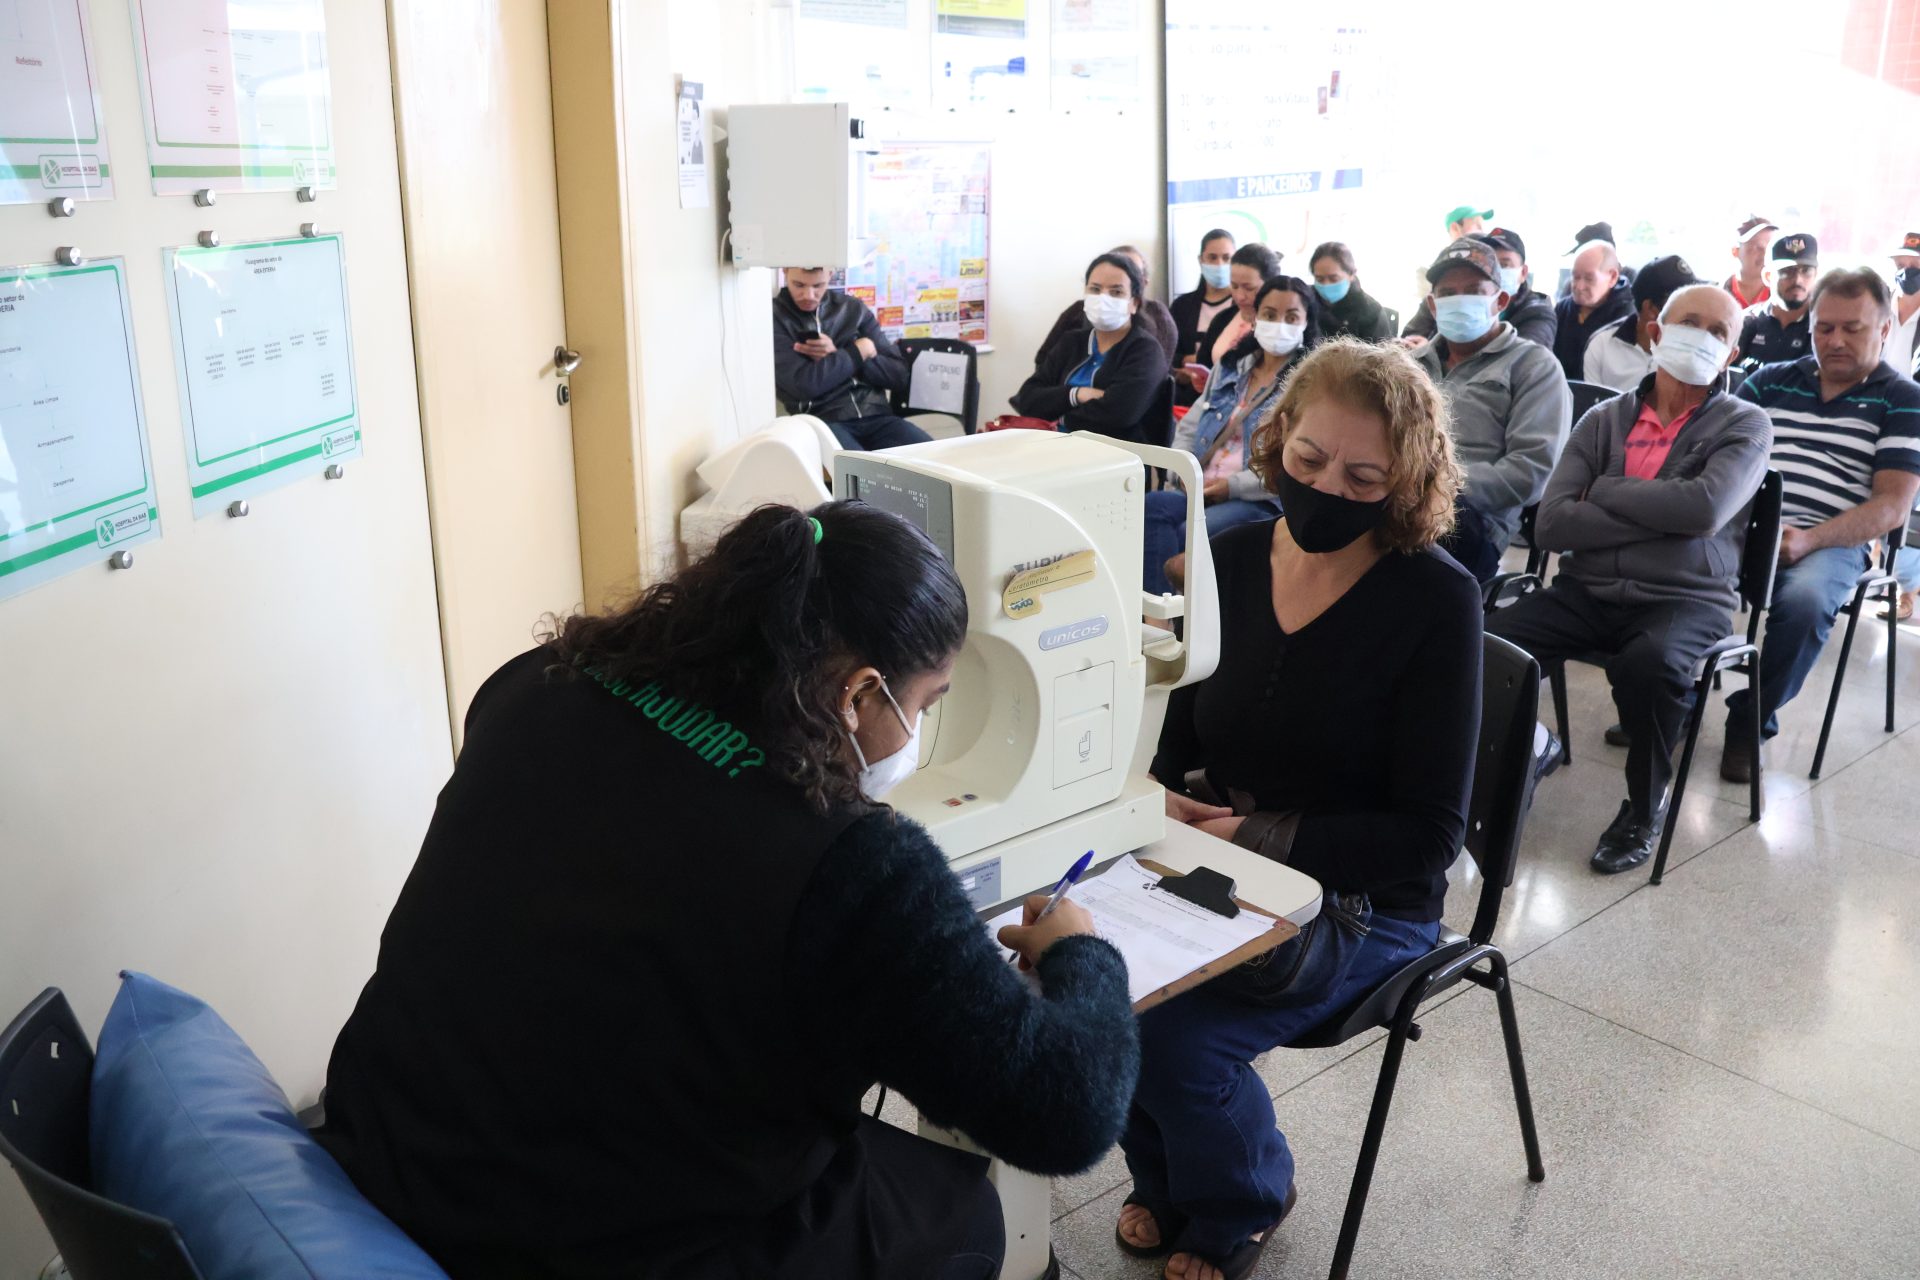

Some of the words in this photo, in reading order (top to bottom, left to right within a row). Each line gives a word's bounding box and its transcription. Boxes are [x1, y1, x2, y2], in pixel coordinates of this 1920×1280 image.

[1237, 178, 1246, 198] E
[1247, 173, 1312, 197] PARCEIROS
[1785, 238, 1806, 250] USA
